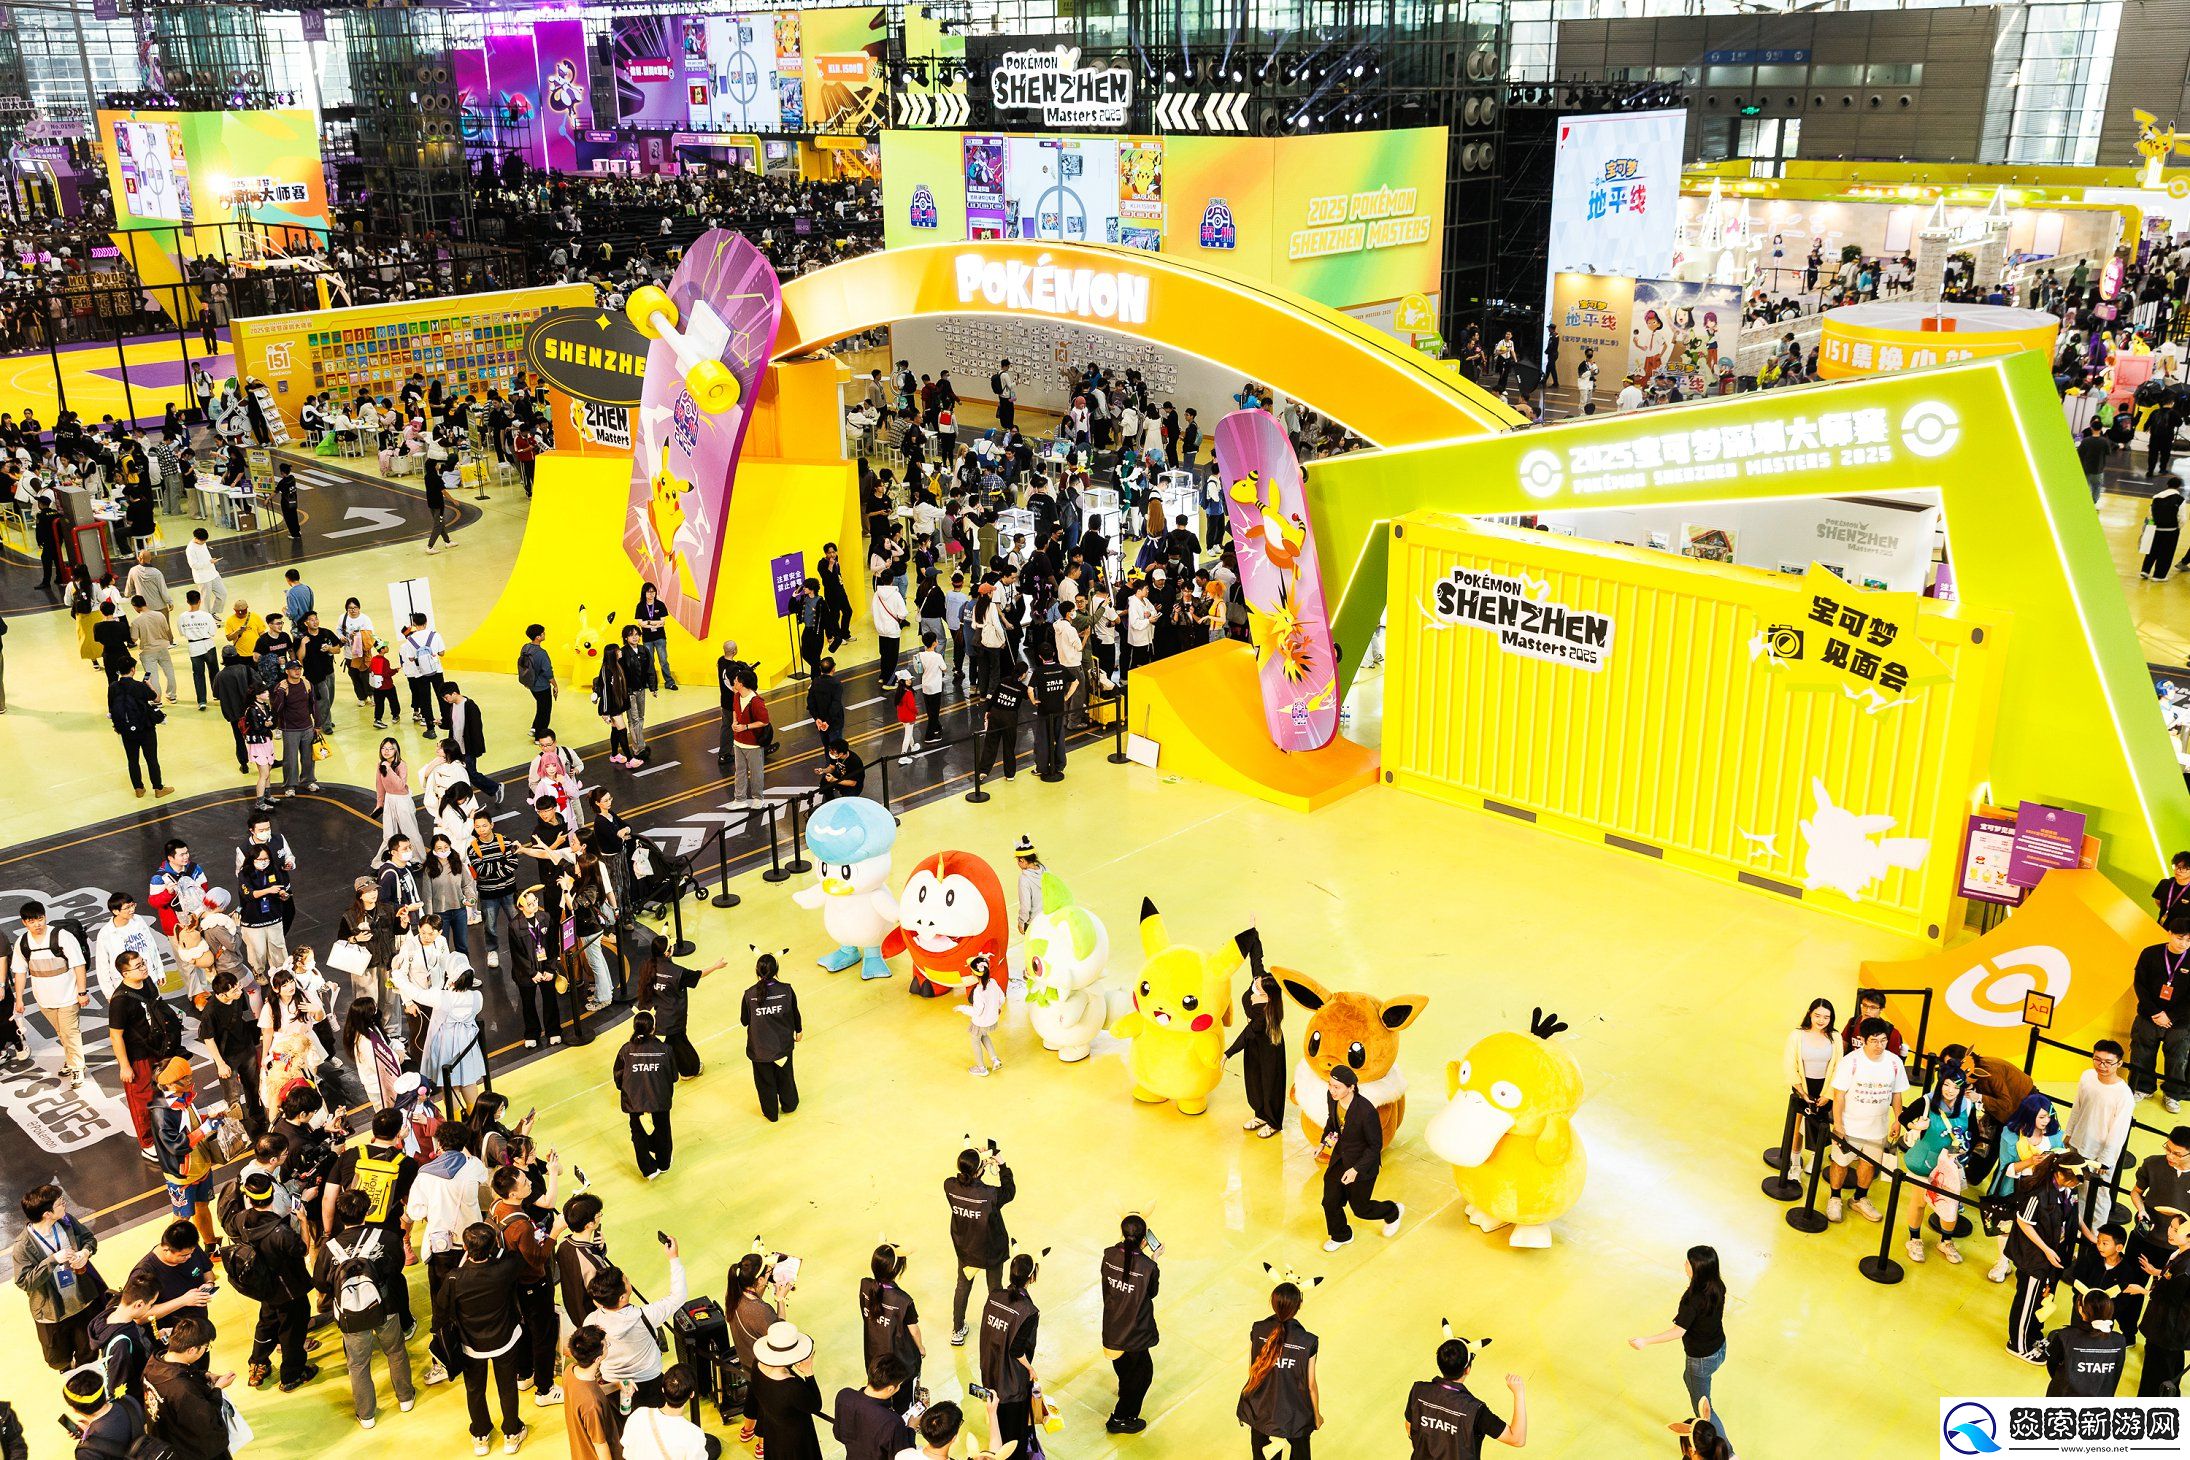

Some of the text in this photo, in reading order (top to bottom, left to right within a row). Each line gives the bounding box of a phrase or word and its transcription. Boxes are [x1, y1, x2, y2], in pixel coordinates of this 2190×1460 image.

[1006, 53, 1058, 70] POKÉMON
[995, 71, 1127, 104] SHENZHEN
[1047, 107, 1121, 122] Masters 2025
[1604, 158, 1639, 180] 宝可梦
[1307, 183, 1417, 226] 2025 POKÉMON
[1586, 184, 1646, 221] 地平线
[1289, 215, 1431, 260] SHENZHEN MASTERS
[955, 252, 1150, 323] POKÉMON
[1565, 312, 1617, 331] 地平线
[545, 338, 647, 377] SHENZHE
[596, 429, 630, 447] Masters
[1746, 453, 1831, 475] MASTERS
[1841, 446, 1892, 465] 2025
[1816, 523, 1899, 549] SHENZHEN
[1454, 570, 1521, 596] POKÉMON
[1437, 582, 1608, 648] SHENZHEN
[1808, 596, 1898, 647] 宝可梦
[1502, 630, 1597, 664] Masters 2025
[1820, 638, 1909, 693] 见面会
[653, 982, 666, 992] AFF
[756, 1005, 783, 1016] STAFF
[2029, 1003, 2049, 1015] 入口
[632, 1063, 660, 1072] STAFF
[27, 1089, 111, 1143] 2025
[375, 1189, 383, 1204] THE
[953, 1206, 981, 1220] STAFF
[1107, 1276, 1135, 1294] STAFF
[863, 1307, 891, 1327] SFF
[987, 1314, 1009, 1332] STAFF
[1274, 1357, 1296, 1369] AFF
[2077, 1362, 2115, 1373] STAFF
[1420, 1415, 1458, 1435] STAFF
